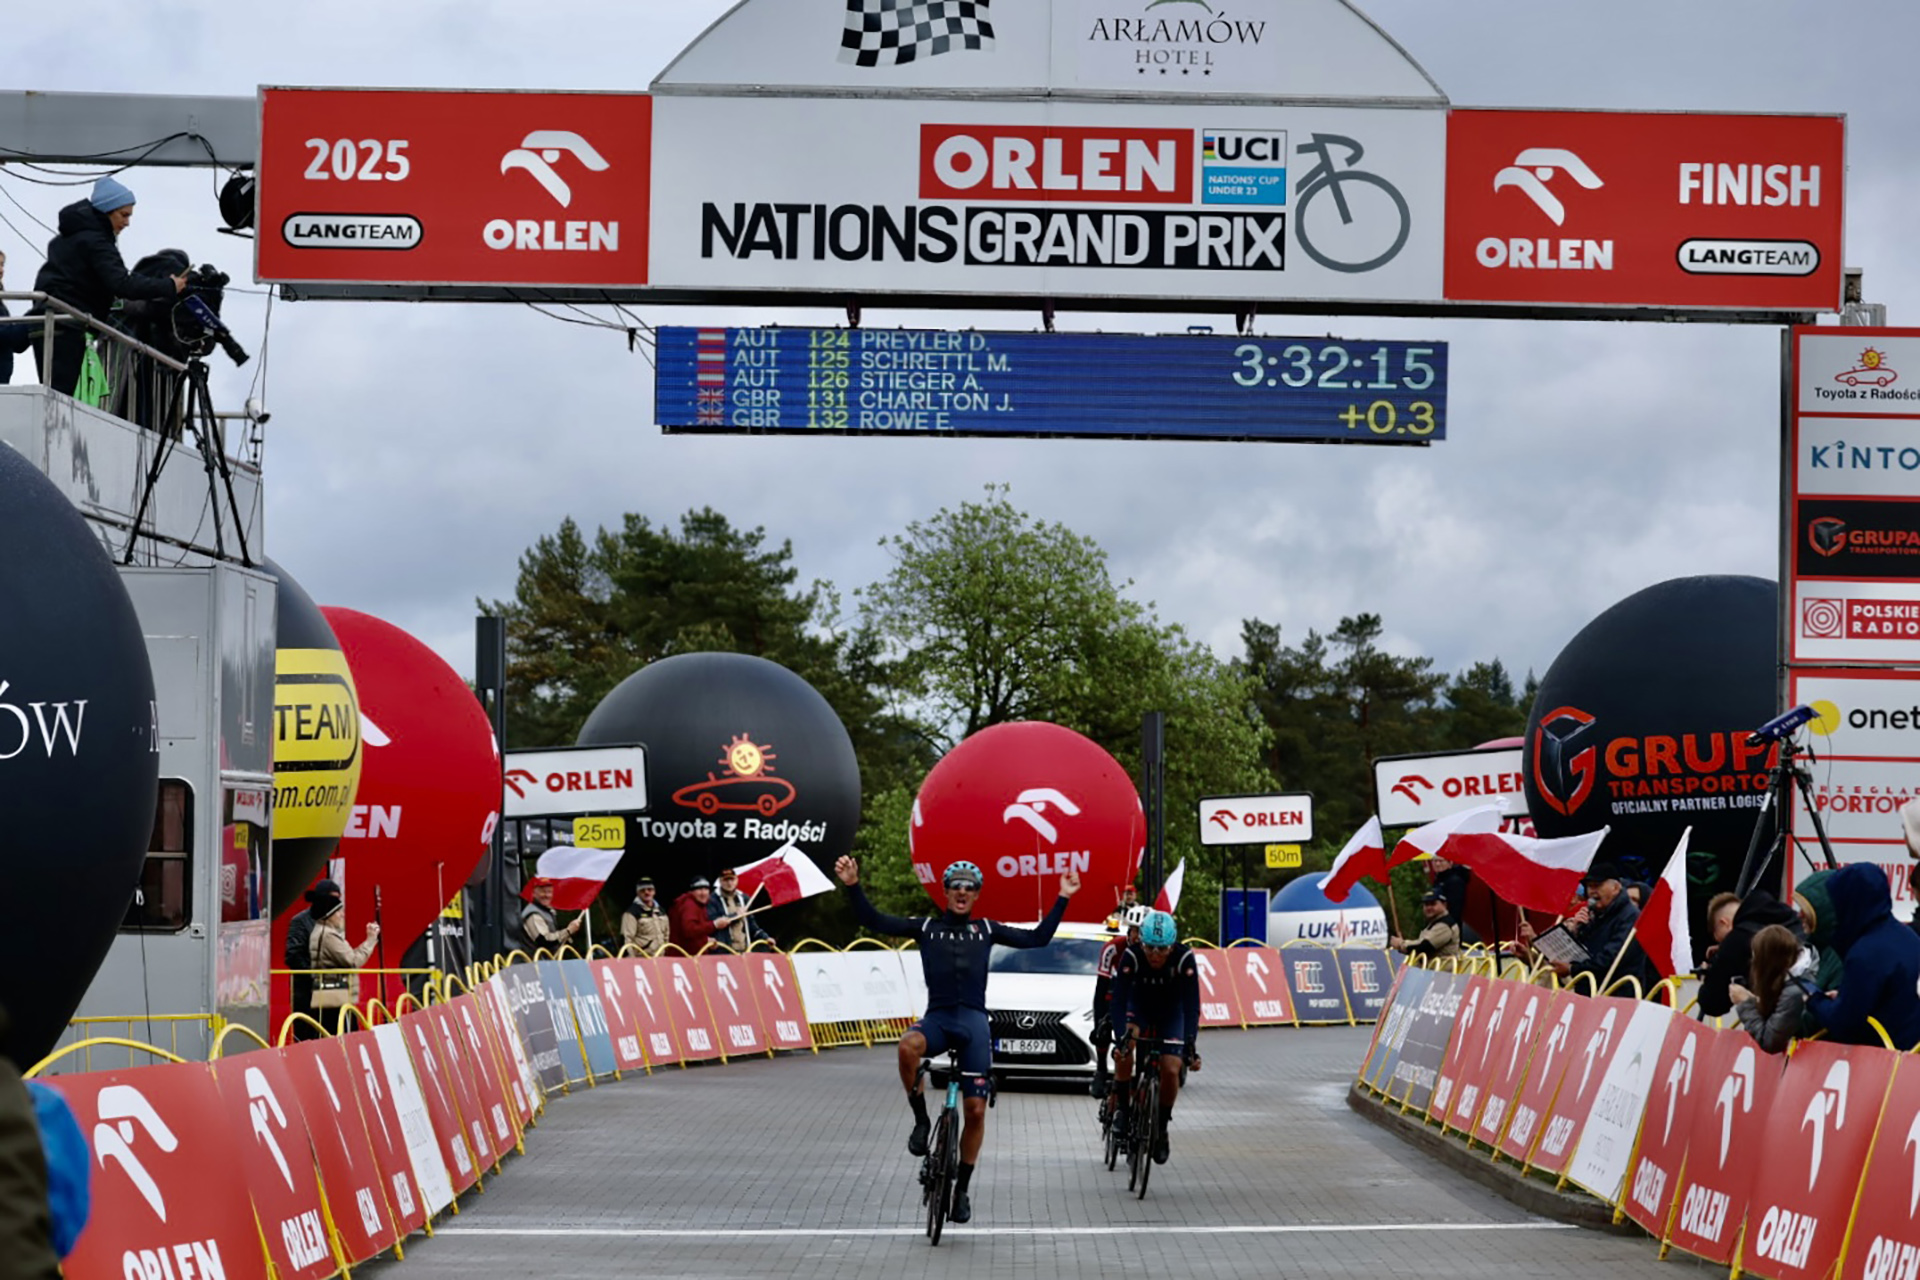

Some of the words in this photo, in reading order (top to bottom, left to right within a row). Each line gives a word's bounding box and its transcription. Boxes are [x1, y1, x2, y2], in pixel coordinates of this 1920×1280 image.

[1088, 11, 1266, 44] ARŁAMÓW
[1135, 47, 1215, 67] HOTEL
[303, 138, 411, 181] 2025
[1217, 136, 1280, 161] UCI
[932, 134, 1177, 193] ORLEN
[1208, 186, 1243, 195] UNDER
[1245, 187, 1258, 196] 23
[1258, 176, 1280, 185] CUP
[1678, 162, 1821, 207] FINISH
[293, 222, 413, 240] LANGTEAM
[482, 218, 619, 252] ORLEN
[701, 203, 958, 263] NATIONS
[967, 212, 1151, 265] GRAND
[1164, 214, 1285, 269] PRIX
[1475, 236, 1614, 271] ORLEN
[1688, 248, 1811, 267] LANGTEAM
[733, 329, 781, 347] AUT
[808, 330, 850, 349] 124
[861, 332, 963, 351] PREYLER
[969, 334, 991, 352] D.
[733, 349, 781, 367] AUT
[808, 350, 850, 369] 125
[860, 351, 982, 371] SCHRETTL
[987, 353, 1013, 372] M.
[1231, 344, 1435, 390] 3:32:15
[733, 369, 781, 387] AUT
[808, 370, 849, 389] 126
[860, 371, 957, 390] STIEGER
[962, 373, 985, 391] A.
[732, 388, 781, 408] GBR
[807, 390, 848, 409] 131
[859, 390, 990, 412] CHARLTON
[995, 393, 1015, 412] J.
[1815, 387, 1857, 401] Toyota
[1860, 391, 1867, 399] z
[1871, 388, 1920, 400] Radości
[731, 408, 781, 428] GBR
[806, 410, 849, 429] 132
[859, 411, 929, 430] ROWE
[935, 412, 955, 431] E.
[1338, 400, 1436, 435] +0.3
[1849, 530, 1920, 546] GRUPA
[1849, 546, 1920, 555] TRANSPORTOW
[1852, 605, 1919, 618] POLSKIE
[1852, 622, 1920, 634] RADIO
[275, 704, 351, 741] TEAM
[1848, 705, 1920, 730] onet
[545, 768, 633, 793] ORLEN
[1443, 772, 1523, 797] ORLEN
[1607, 773, 1770, 798] TRANSPORTO
[1611, 800, 1667, 815] OFICJALNY
[1671, 796, 1726, 811] PARTNER
[1729, 793, 1777, 808] LOGIS
[1803, 795, 1911, 814] PORTOW
[636, 817, 718, 843] Toyota
[724, 823, 737, 839] z
[743, 818, 827, 843] Radości
[1243, 810, 1303, 827] ORLEN
[578, 824, 621, 843] 25m
[996, 850, 1090, 877] ORLEN
[1269, 850, 1299, 864] 50m
[930, 932, 984, 941] ITALIA
[1298, 922, 1335, 939] LUK
[1253, 999, 1283, 1018] ORLEN
[1632, 1156, 1667, 1217] ORLEN
[1680, 1182, 1730, 1243] ORLEN
[281, 1208, 329, 1272] ORLEN
[1756, 1205, 1818, 1270] ORLEN
[122, 1239, 227, 1280] ORLEN
[1863, 1234, 1920, 1280] ORLEN
